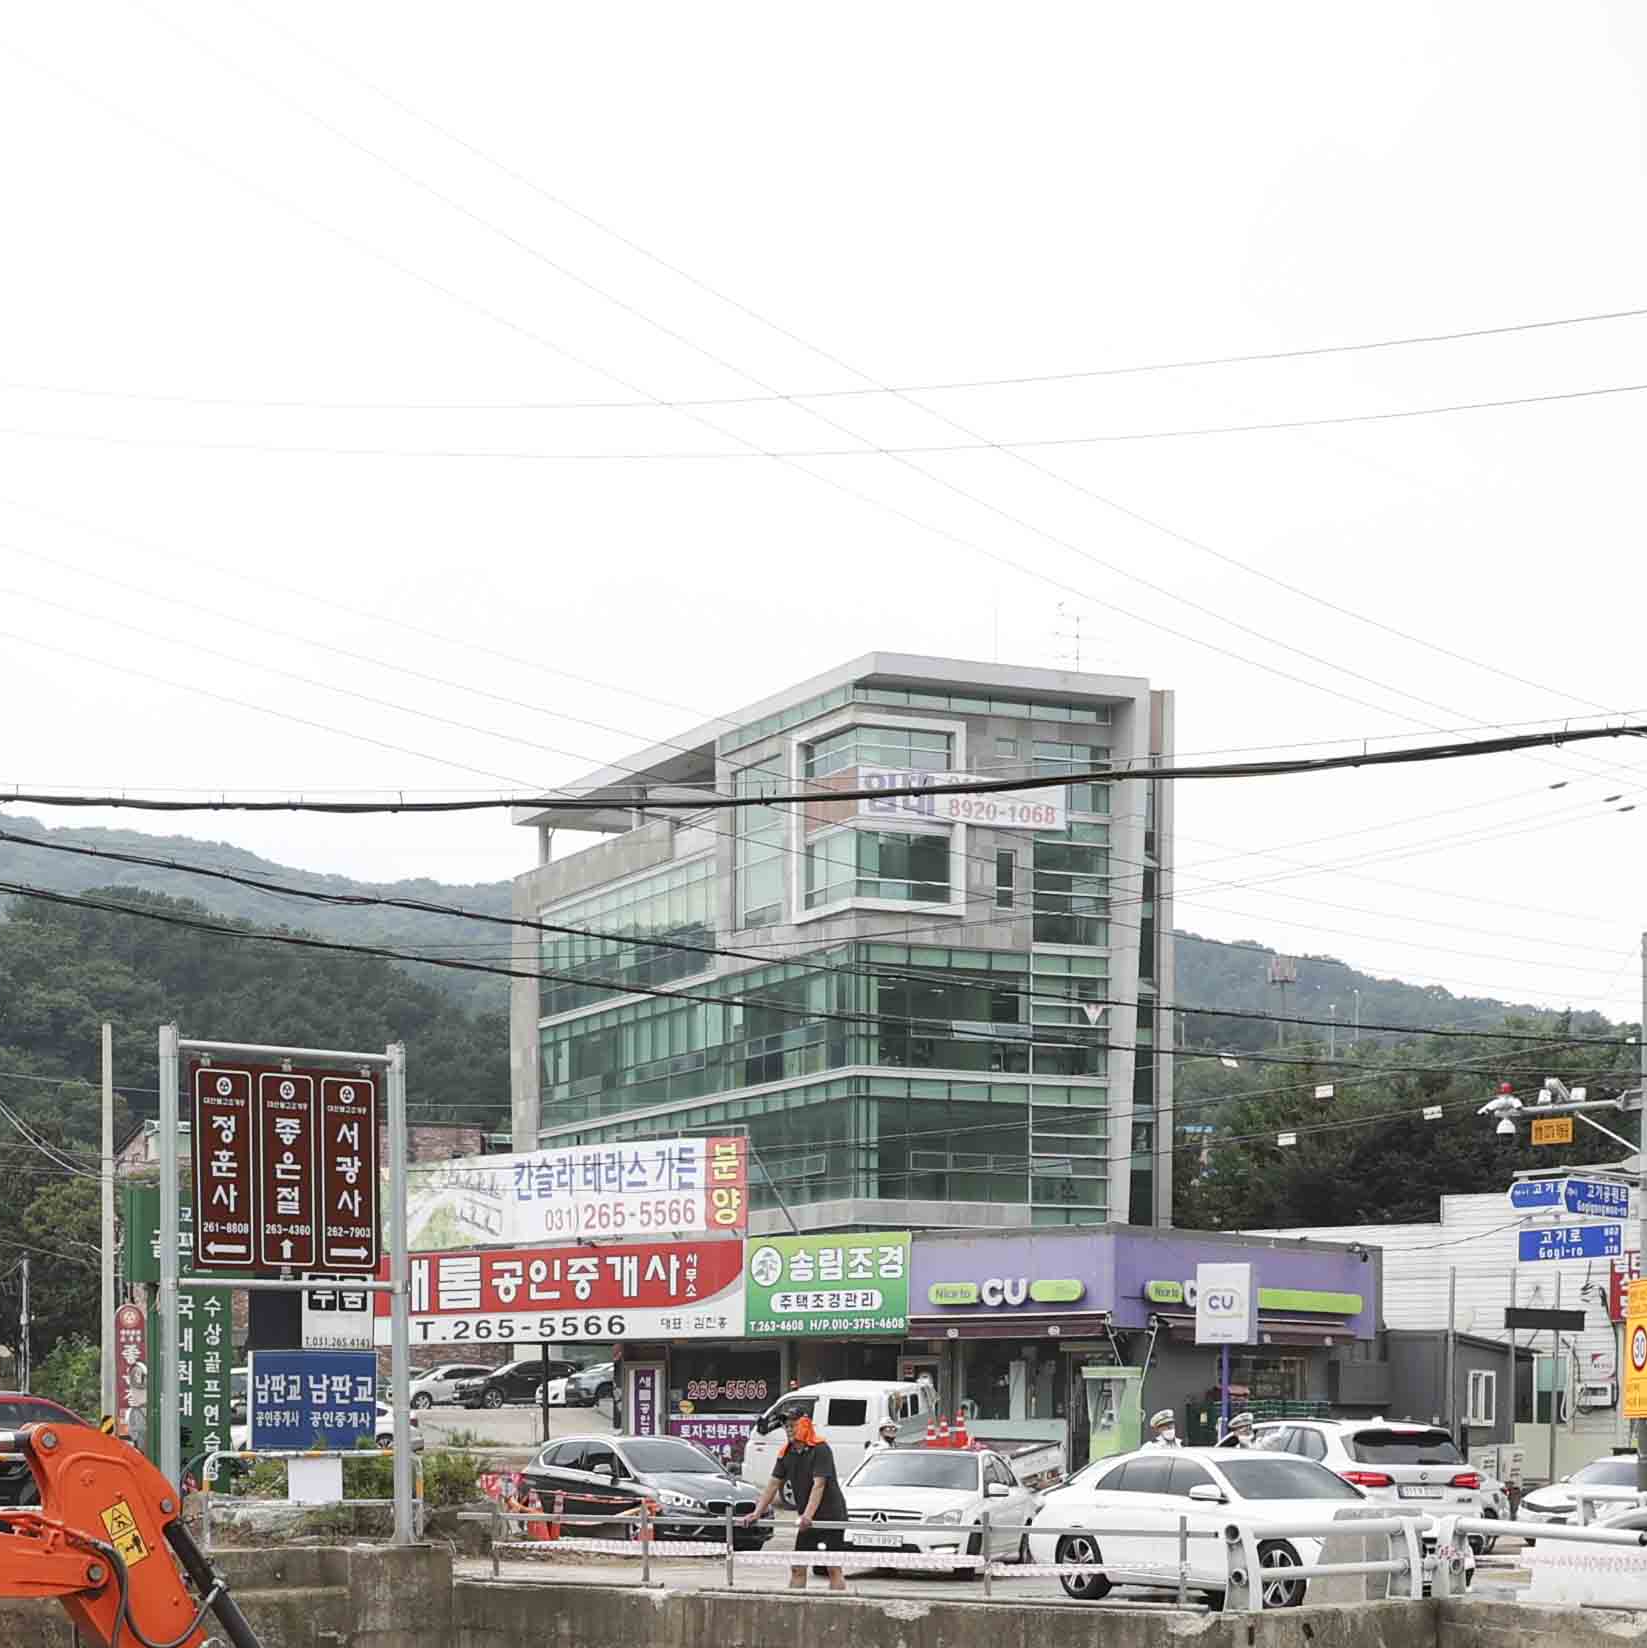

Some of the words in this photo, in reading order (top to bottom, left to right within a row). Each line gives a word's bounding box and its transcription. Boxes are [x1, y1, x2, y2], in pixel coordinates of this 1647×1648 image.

[210, 1115, 239, 1213] 정훈사
[274, 1117, 302, 1215] 좋은절
[335, 1122, 362, 1218] 서광사
[513, 1153, 575, 1201] 칸슬라
[583, 1149, 648, 1194] 테라스
[655, 1146, 696, 1191] 가든
[711, 1143, 742, 1226] 분양
[1540, 1229, 1583, 1244] 고기로
[789, 1245, 904, 1282] 송림조경
[1539, 1246, 1583, 1260] Gogi-ro
[491, 1254, 681, 1303] 공인중개사
[685, 1254, 698, 1298] 사무소
[981, 1278, 1027, 1307] CU
[1208, 1295, 1234, 1310] CU
[415, 1314, 627, 1341] T.265-5566
[255, 1374, 302, 1404] 남판교
[308, 1374, 374, 1404] 남판교
[687, 1380, 768, 1400] 265-5566
[256, 1410, 300, 1427] 공인중개사
[310, 1411, 372, 1428] 공인중개사
